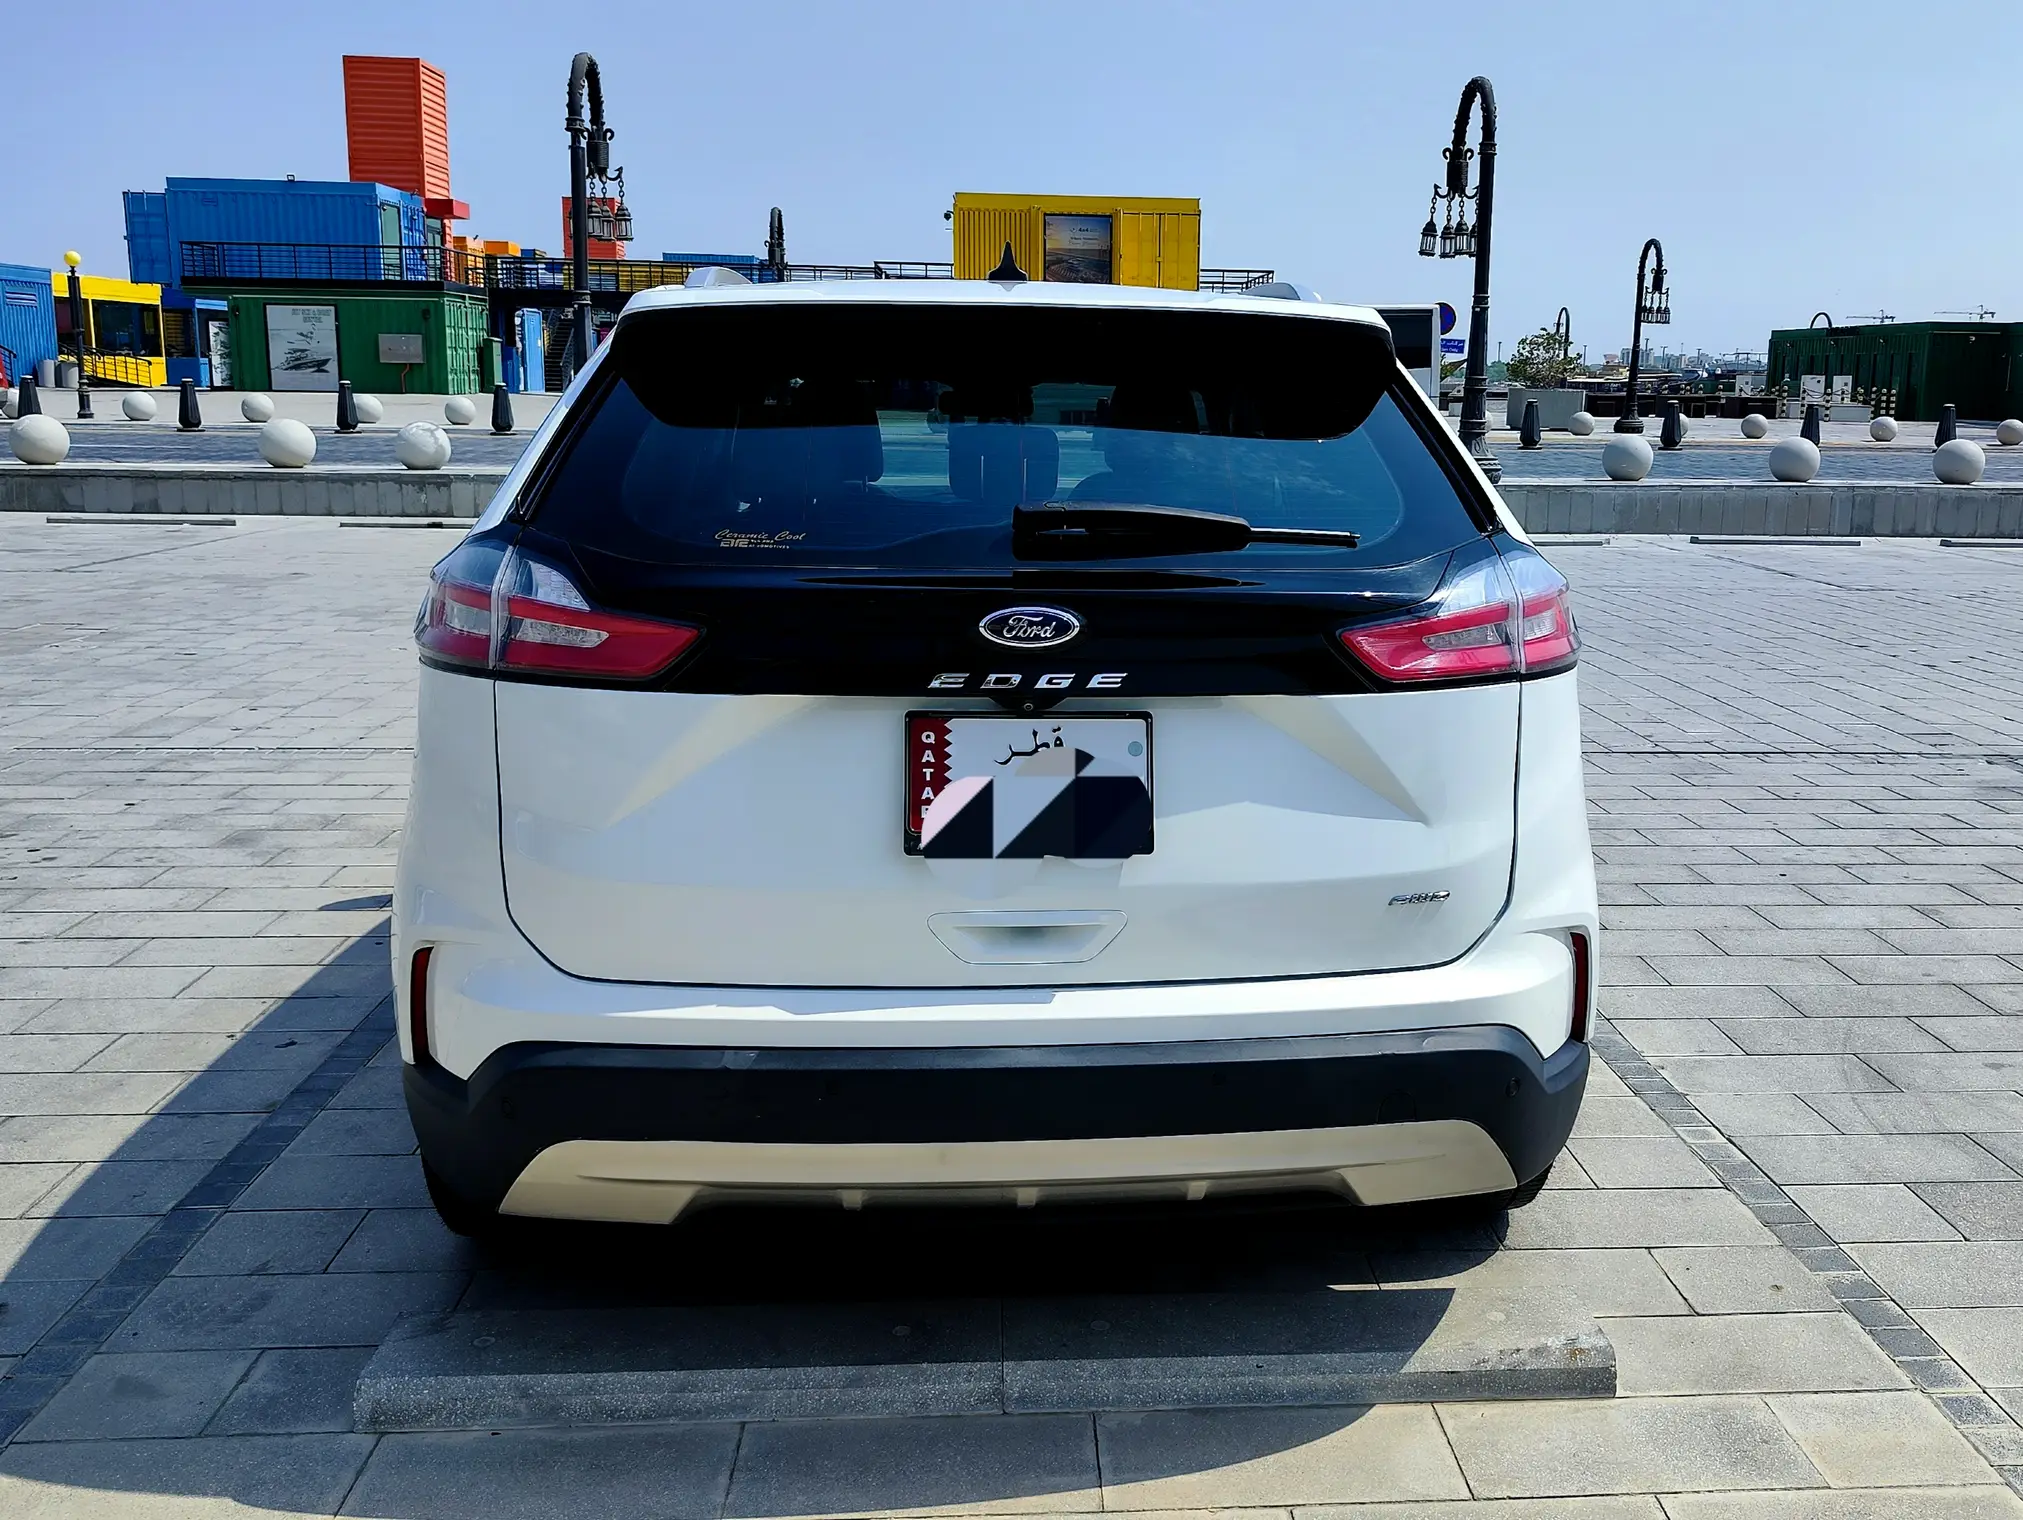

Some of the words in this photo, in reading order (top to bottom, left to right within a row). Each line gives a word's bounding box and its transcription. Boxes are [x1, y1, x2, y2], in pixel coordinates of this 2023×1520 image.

[714, 529, 769, 540] Ceramic
[774, 530, 806, 541] Cool
[1003, 615, 1055, 638] Ford
[928, 673, 1128, 688] EDGE
